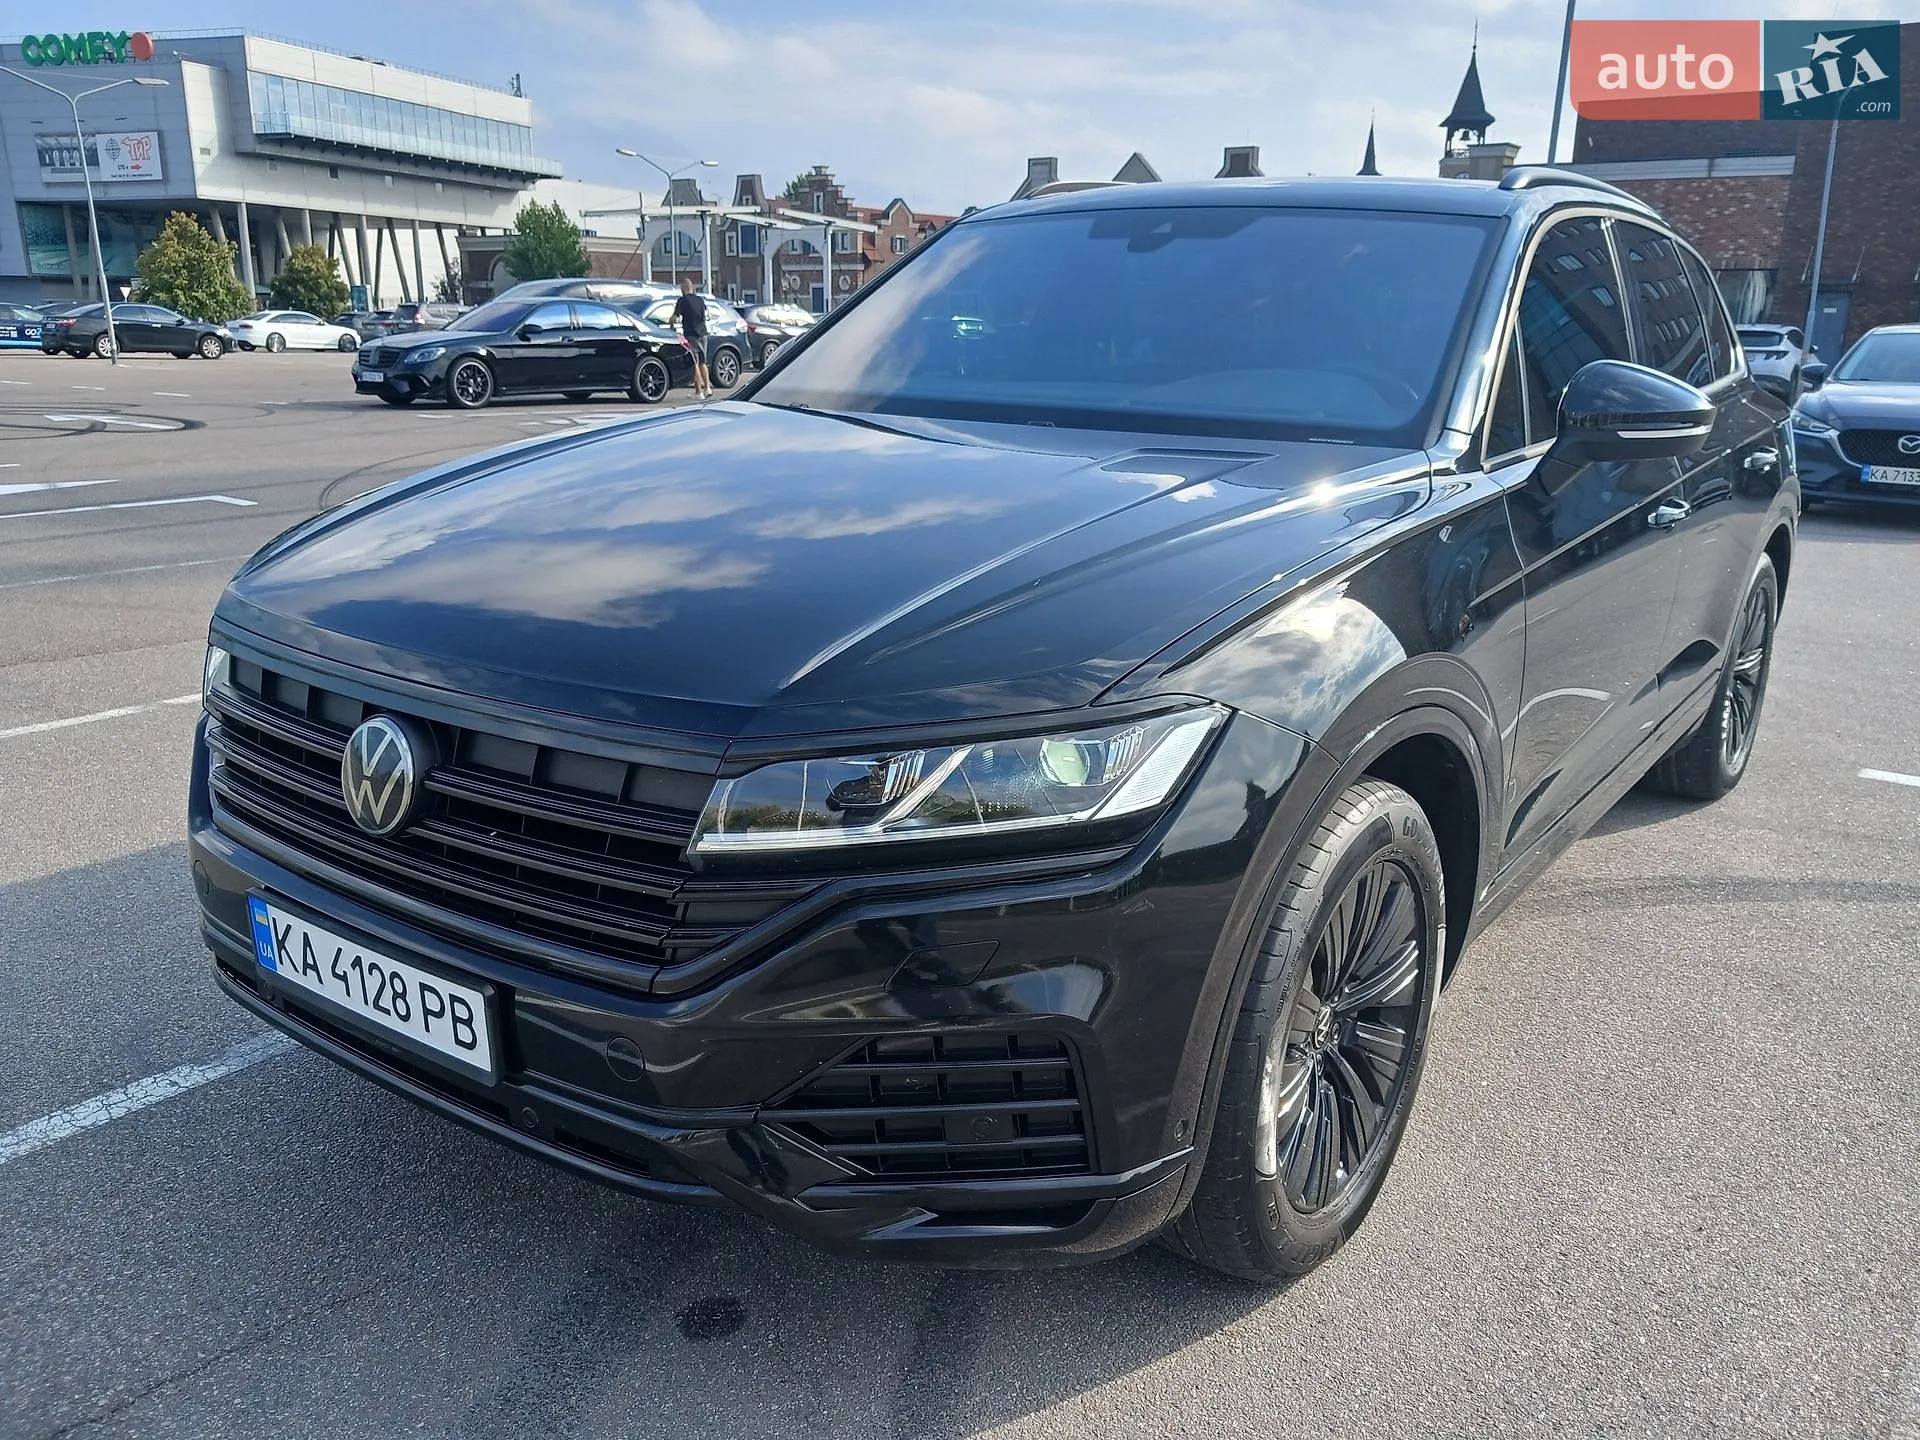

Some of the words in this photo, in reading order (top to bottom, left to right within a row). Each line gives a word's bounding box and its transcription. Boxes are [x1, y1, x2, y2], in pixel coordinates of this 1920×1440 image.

[22, 30, 129, 66] COMFY
[1870, 469, 1888, 481] KA
[259, 941, 276, 961] UA
[271, 916, 325, 985] KA
[330, 946, 412, 1023] 4128
[418, 980, 478, 1050] PB
